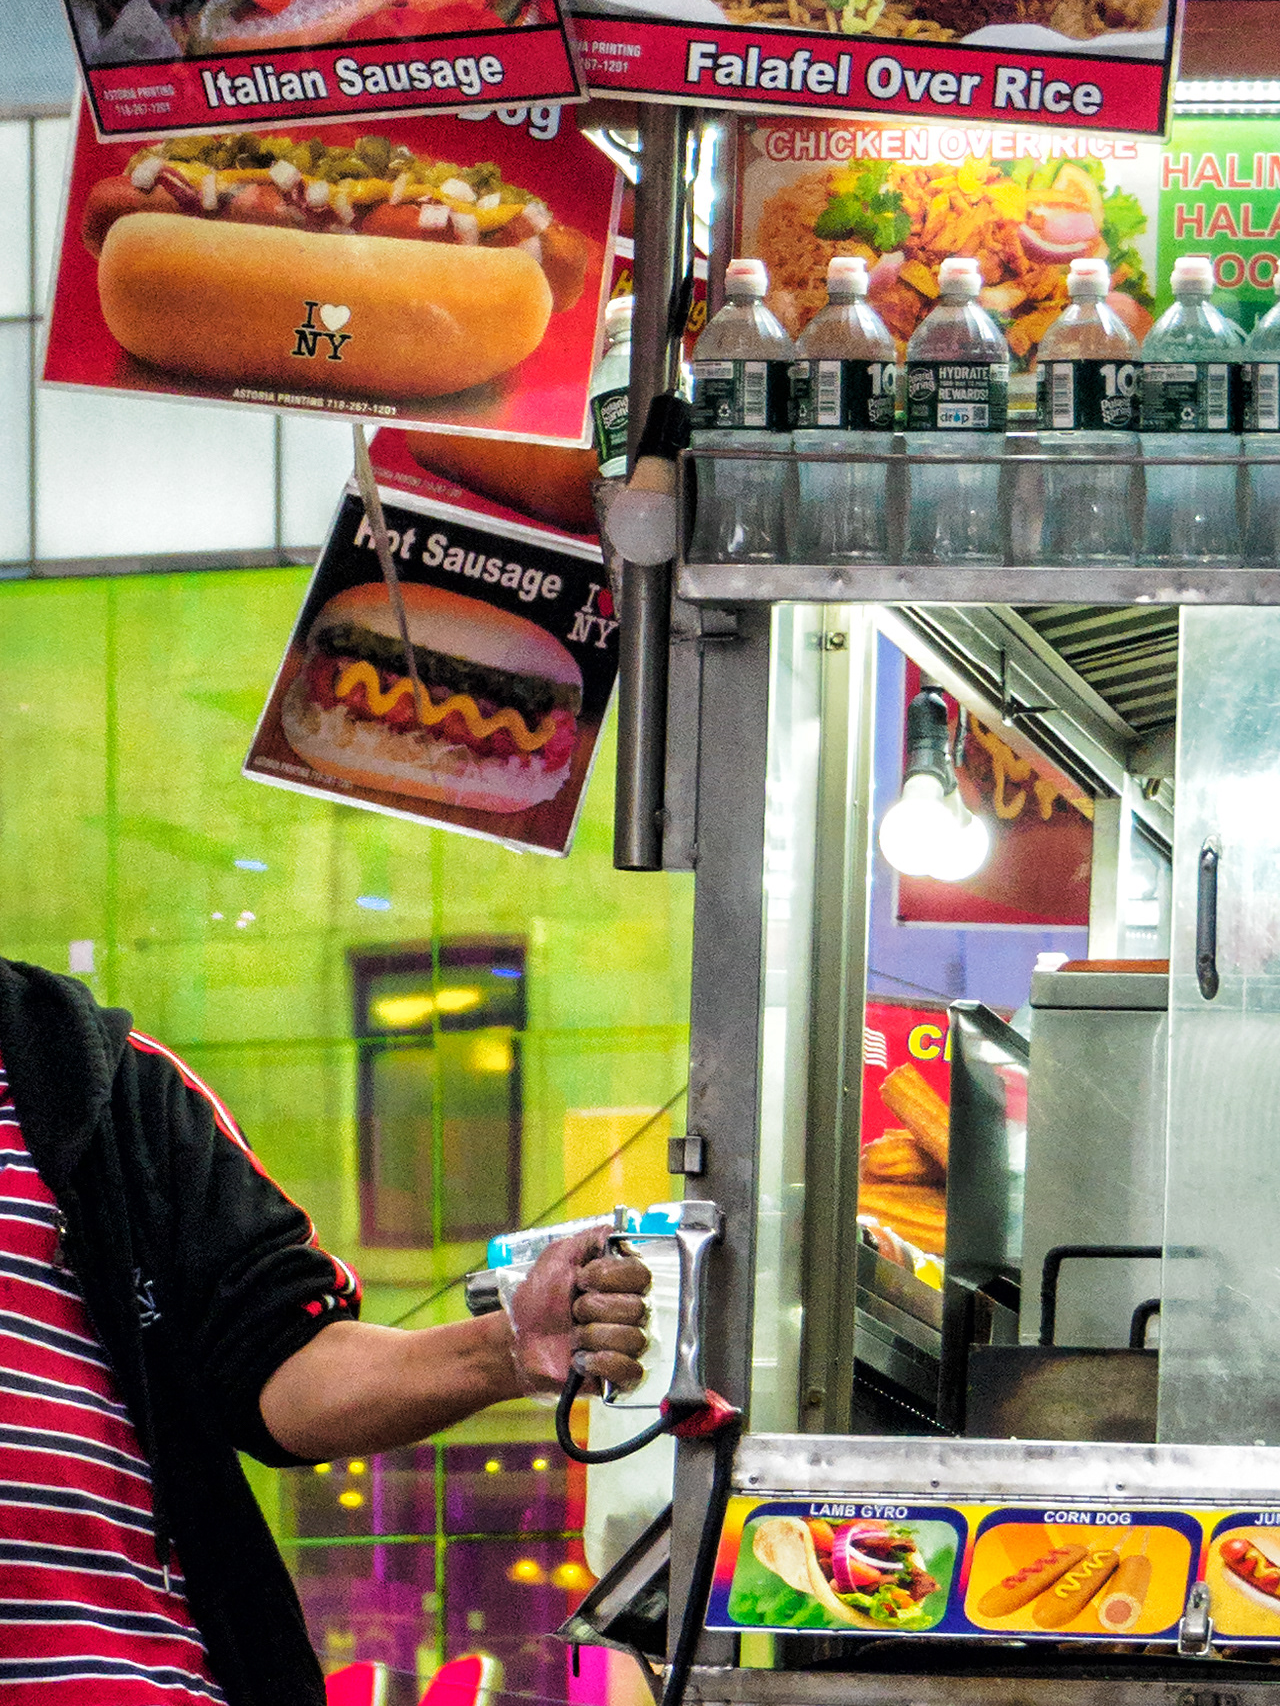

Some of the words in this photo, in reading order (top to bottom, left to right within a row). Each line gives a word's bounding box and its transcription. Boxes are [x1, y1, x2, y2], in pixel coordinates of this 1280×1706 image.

[202, 67, 328, 109] Italian
[334, 52, 504, 99] Sausage
[687, 40, 849, 96] Falafel
[866, 59, 981, 106] Over
[993, 69, 1102, 116] Rice
[766, 128, 928, 161] CHICKEN
[938, 129, 1043, 159] OVER
[1051, 131, 1136, 159] RICE
[302, 302, 319, 330] I
[292, 330, 351, 362] NY
[422, 536, 563, 601] Sausage
[566, 615, 620, 649] NY
[809, 1503, 857, 1517] LAMB
[860, 1504, 908, 1519] GYRO
[1043, 1510, 1090, 1523] CORN
[1095, 1511, 1133, 1524] DOG
